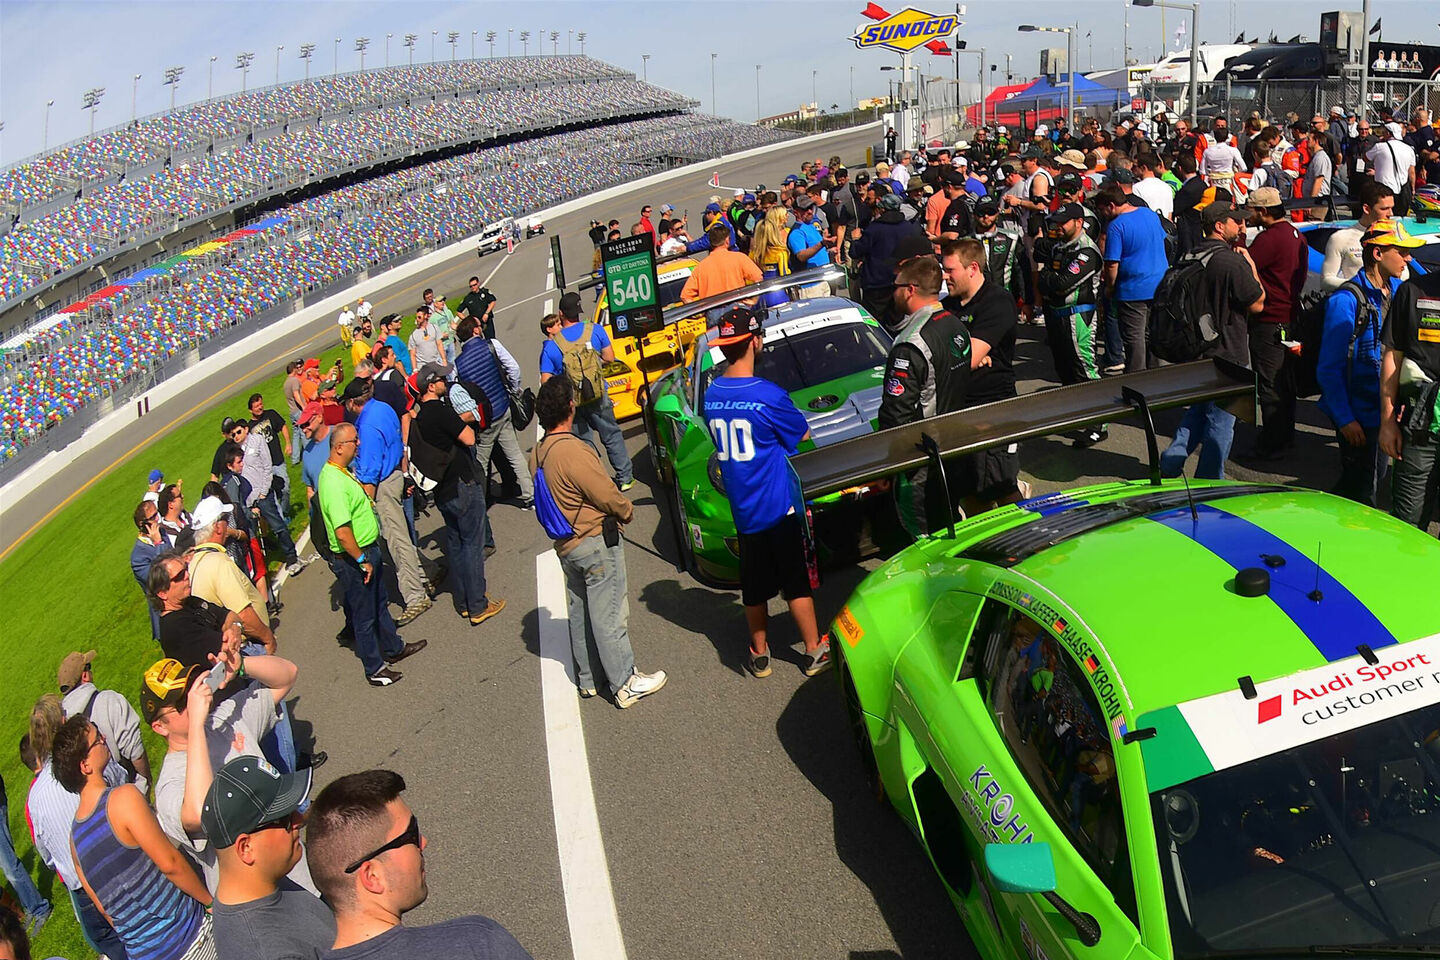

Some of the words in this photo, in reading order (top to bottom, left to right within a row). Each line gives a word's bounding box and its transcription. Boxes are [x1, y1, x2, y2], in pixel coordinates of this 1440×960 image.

[863, 18, 954, 43] SUNOCO
[609, 243, 626, 252] BLACK
[616, 246, 636, 255] RACING
[608, 264, 621, 274] GTD
[629, 259, 649, 269] DAYTONA
[612, 273, 651, 306] 540
[724, 401, 767, 411] LIGHT
[709, 419, 756, 462] 00
[1062, 625, 1092, 662] HAASE
[1092, 665, 1122, 719] KROHN
[1291, 671, 1354, 707] Audi
[1355, 652, 1432, 685] Sport
[1301, 674, 1426, 727] customer
